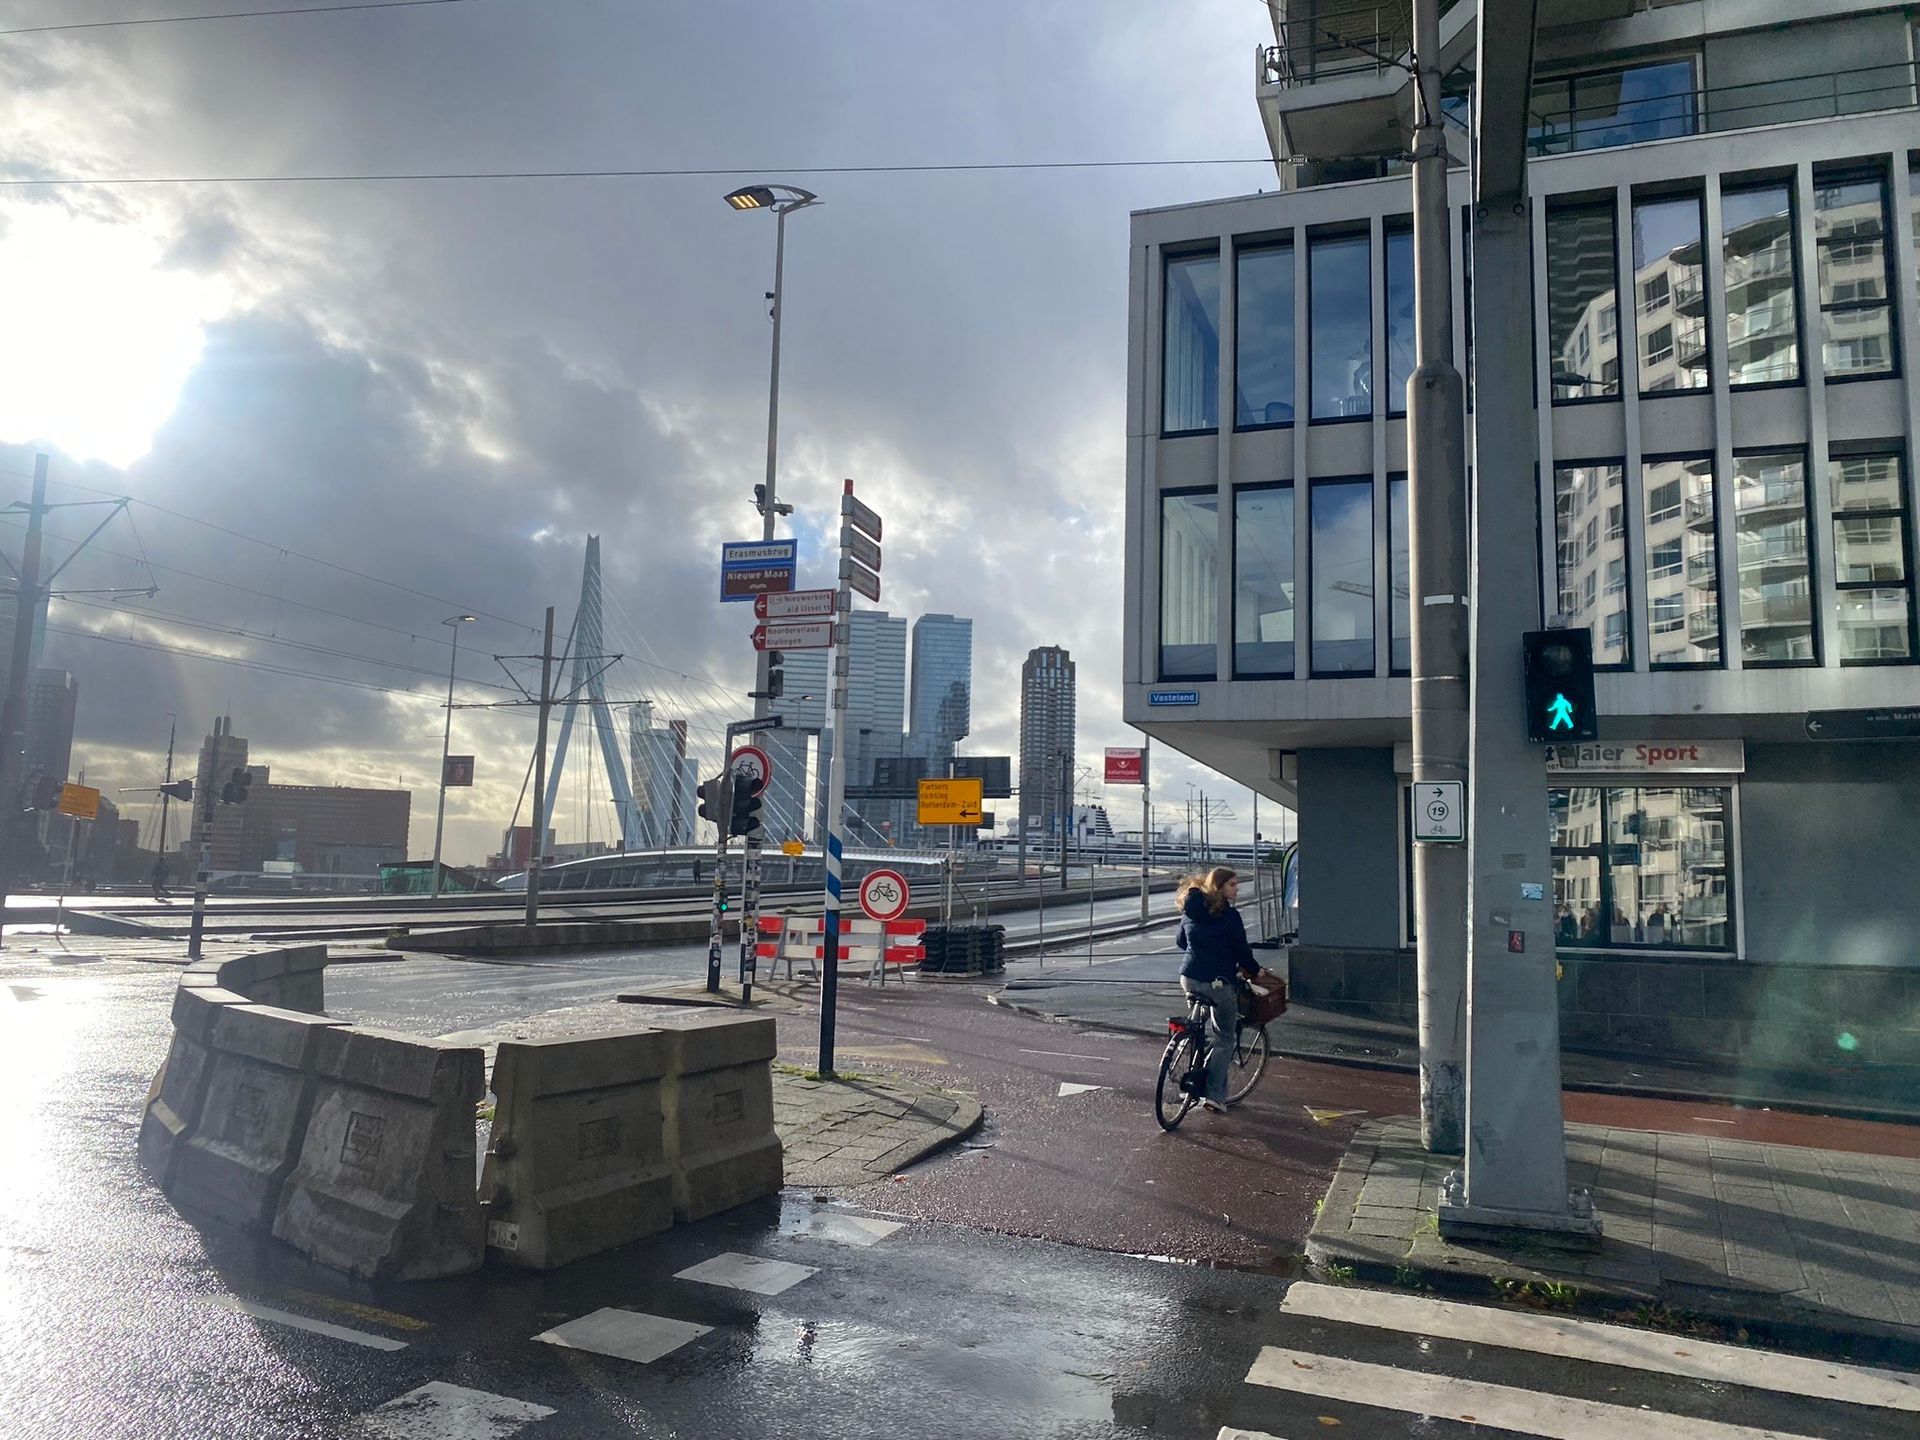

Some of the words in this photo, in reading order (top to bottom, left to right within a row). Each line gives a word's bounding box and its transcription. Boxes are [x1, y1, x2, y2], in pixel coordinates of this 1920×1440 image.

[729, 548, 789, 558] Erasmusbrug
[727, 571, 762, 580] Nieuwe
[764, 569, 789, 579] Maas
[1153, 694, 1195, 702] Vasteland
[1635, 744, 1698, 765] Sport
[1432, 806, 1445, 816] 19
